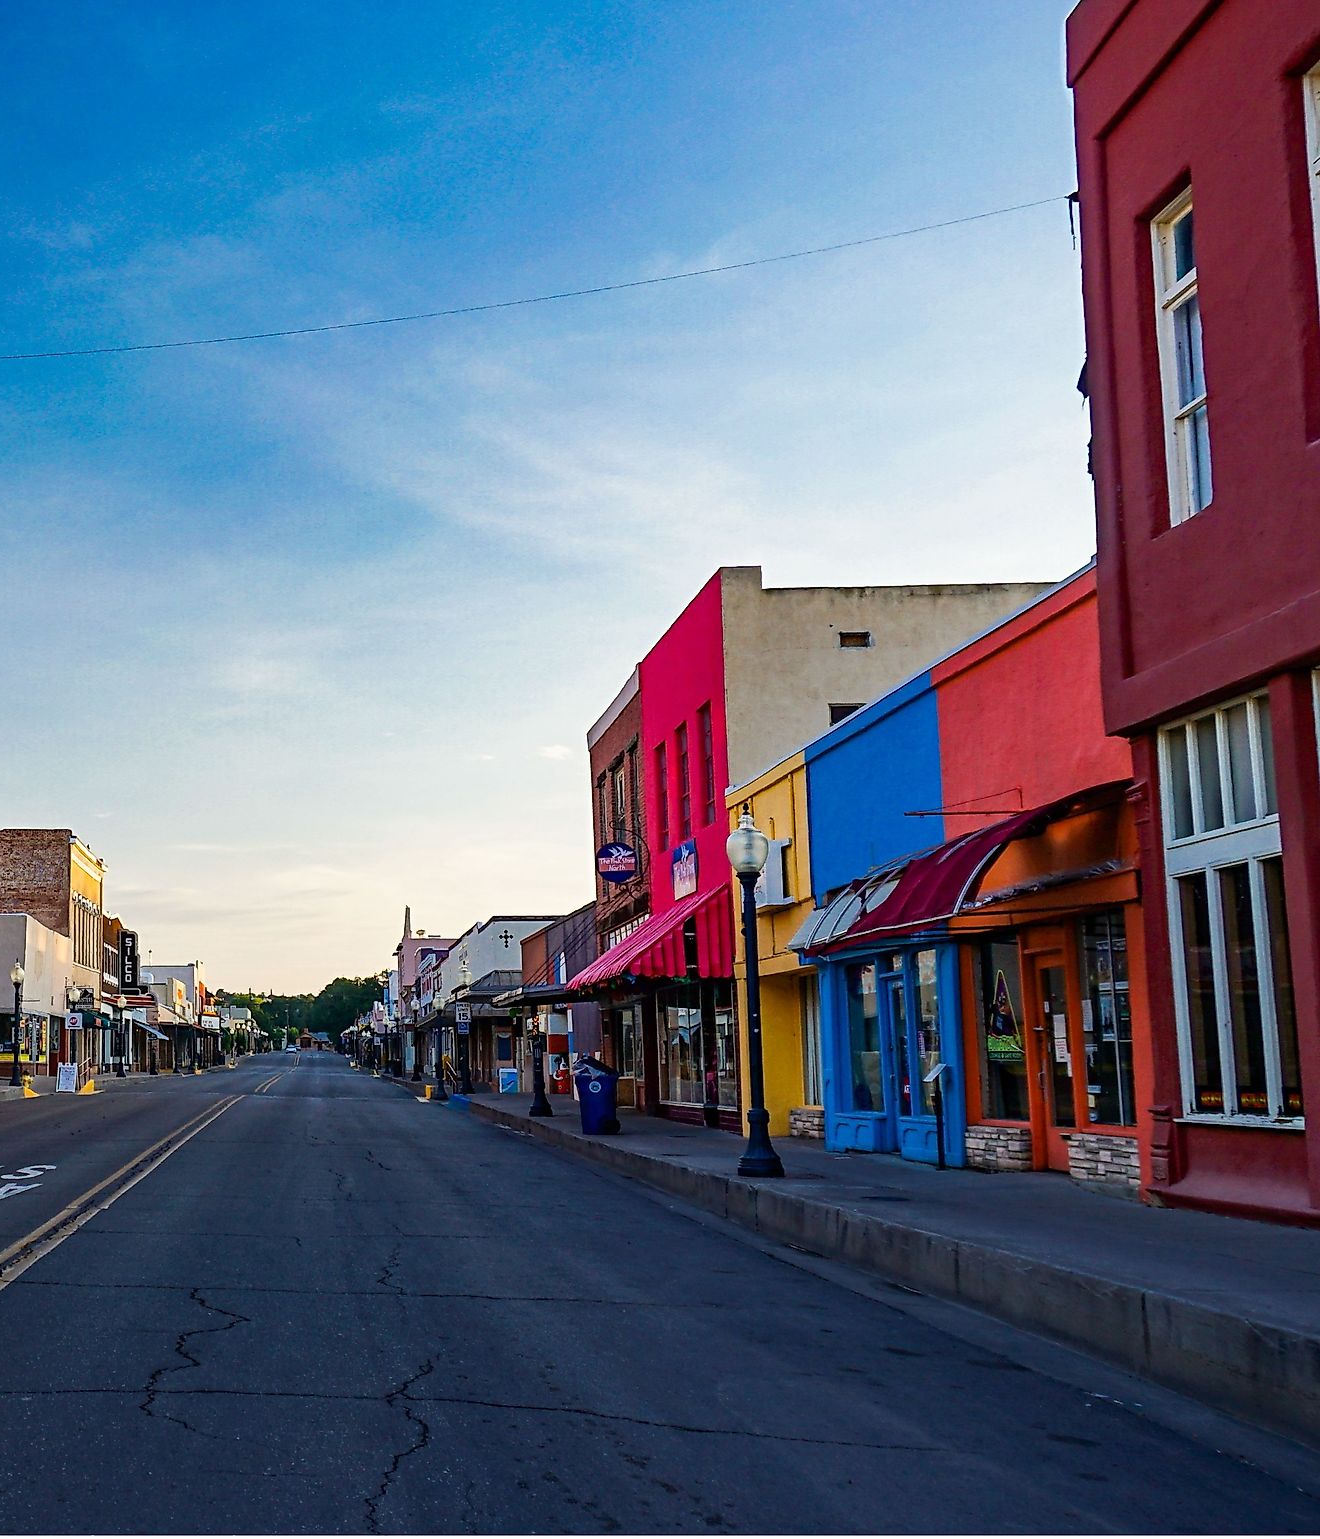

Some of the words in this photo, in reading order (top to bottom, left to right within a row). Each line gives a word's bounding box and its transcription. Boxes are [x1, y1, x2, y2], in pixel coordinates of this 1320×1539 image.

[608, 863, 626, 872] North
[124, 937, 133, 983] SILCO
[457, 1012, 469, 1021] 15
